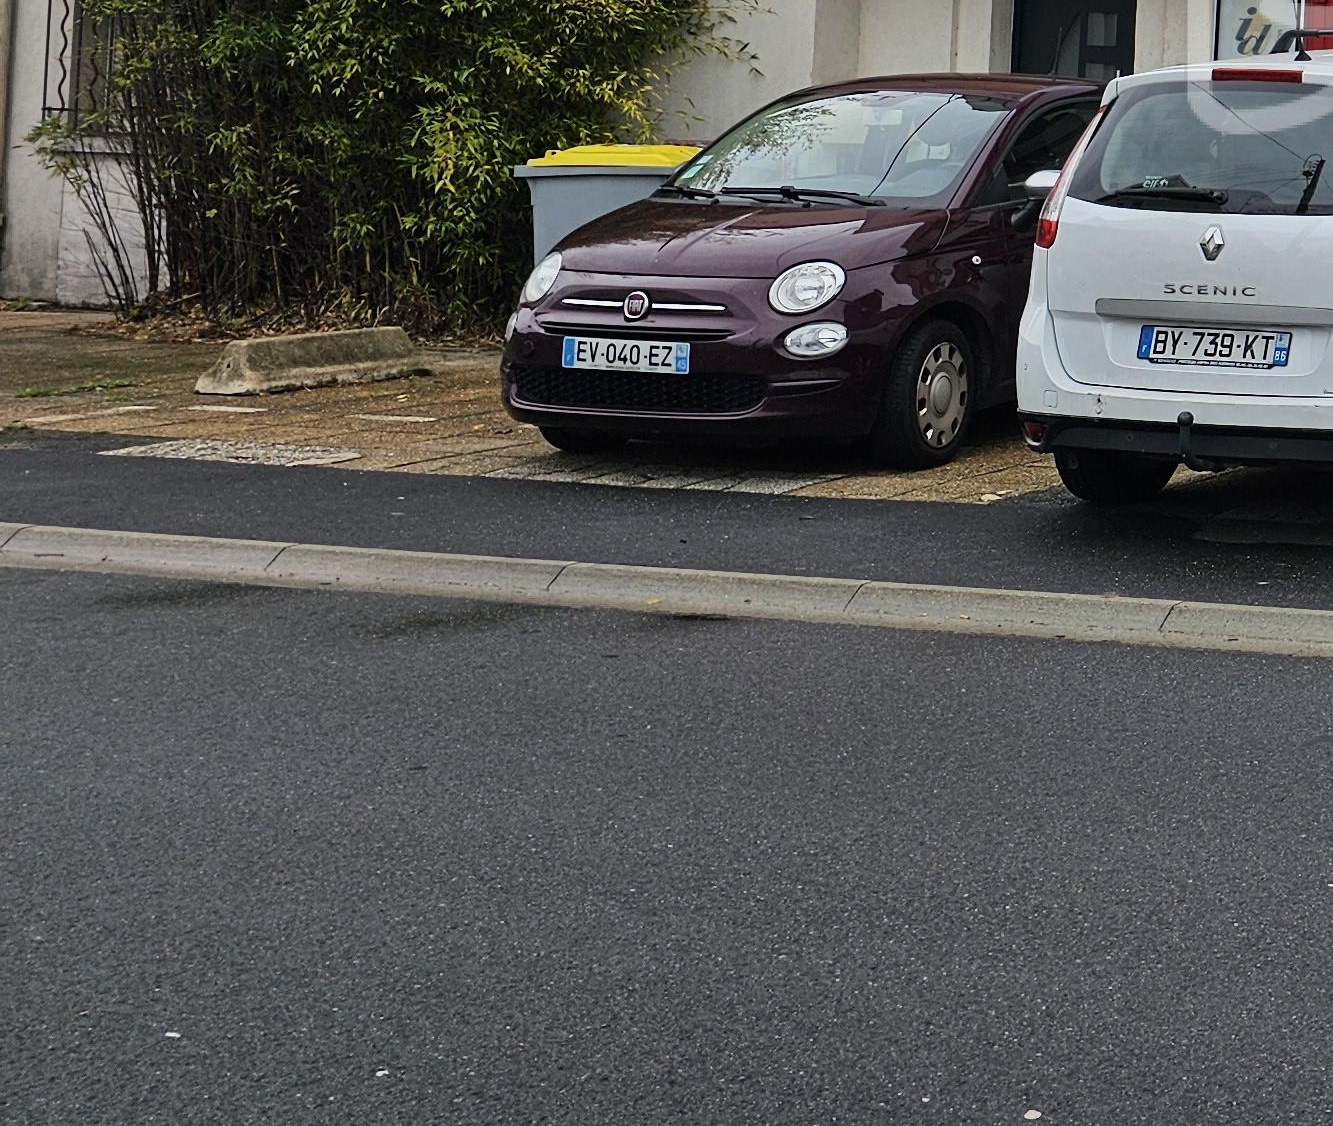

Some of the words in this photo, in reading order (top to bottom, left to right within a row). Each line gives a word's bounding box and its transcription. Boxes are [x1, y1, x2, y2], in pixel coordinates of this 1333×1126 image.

[1163, 284, 1256, 297] SCENIC
[576, 341, 673, 367] EV-040-EZ
[1153, 330, 1275, 360] BY-739-KT
[1274, 350, 1287, 361] 86
